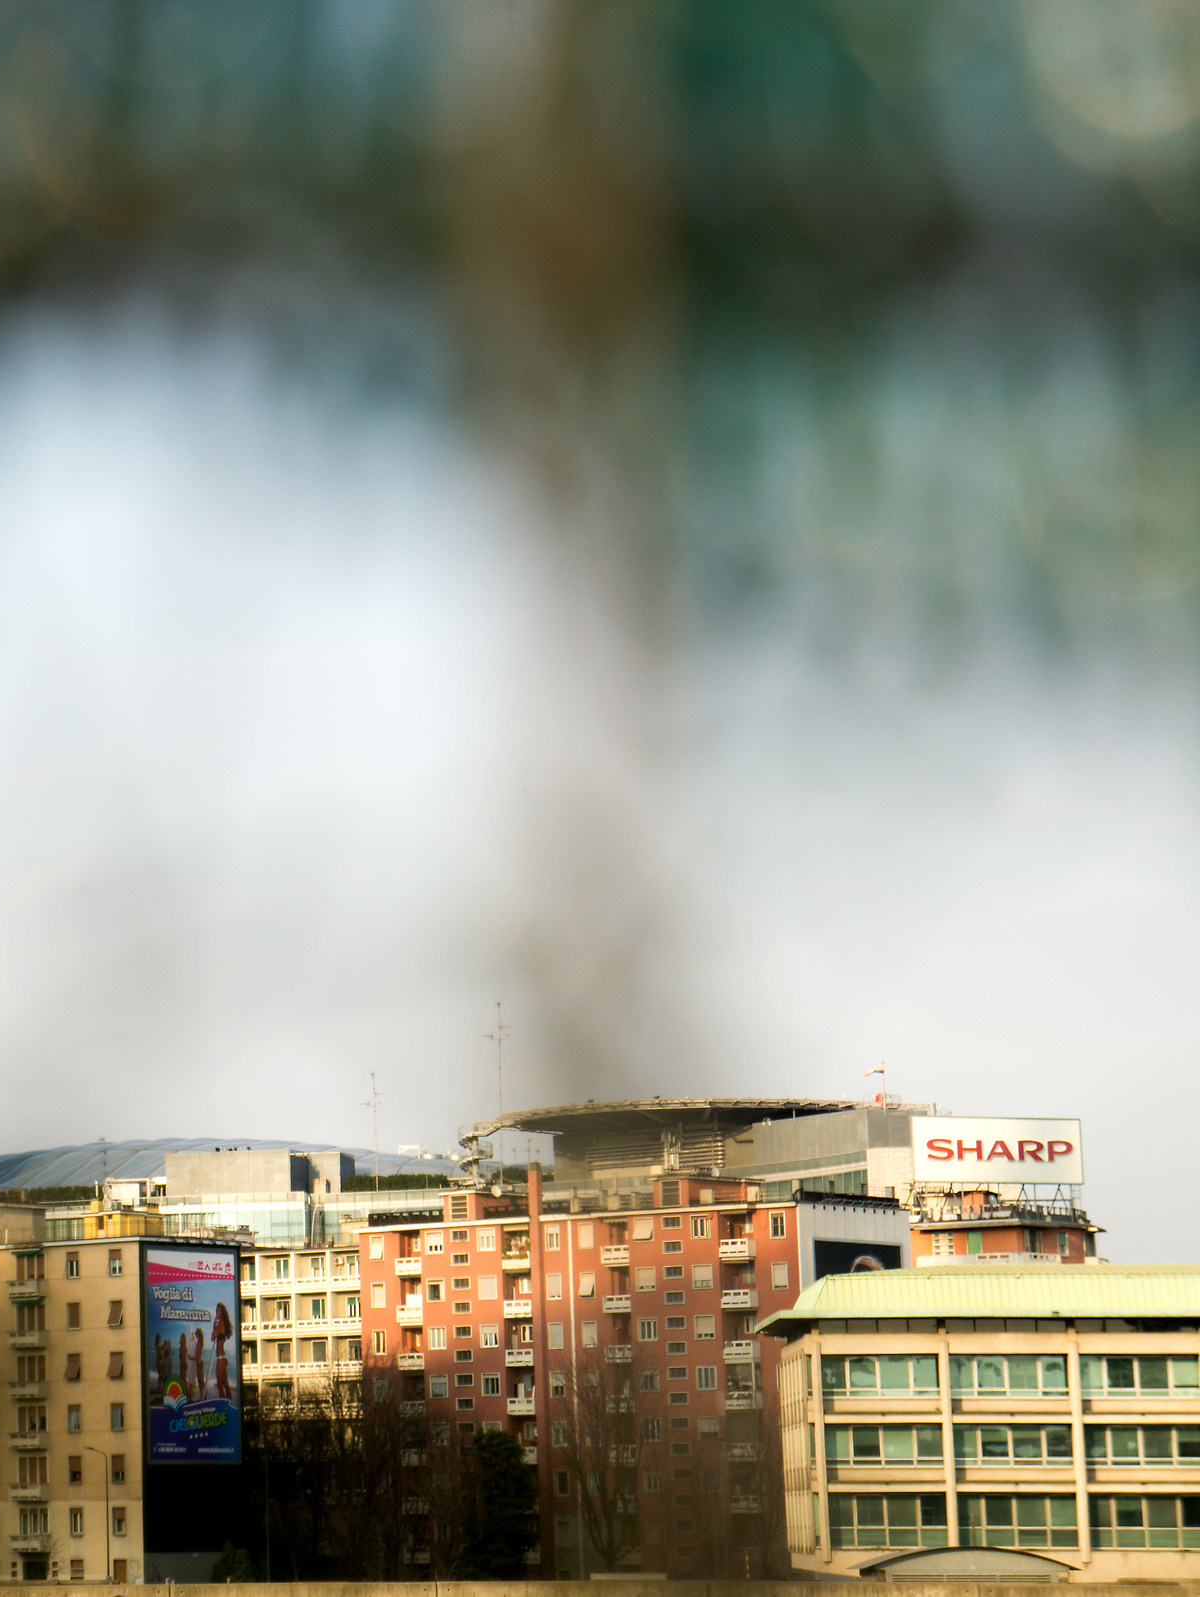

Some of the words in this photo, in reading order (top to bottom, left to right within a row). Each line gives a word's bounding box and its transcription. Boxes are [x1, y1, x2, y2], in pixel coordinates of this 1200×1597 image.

[926, 1138, 1073, 1162] SHARP
[152, 1286, 181, 1304] Voglia
[182, 1286, 193, 1301] di
[160, 1305, 211, 1322] Maremma
